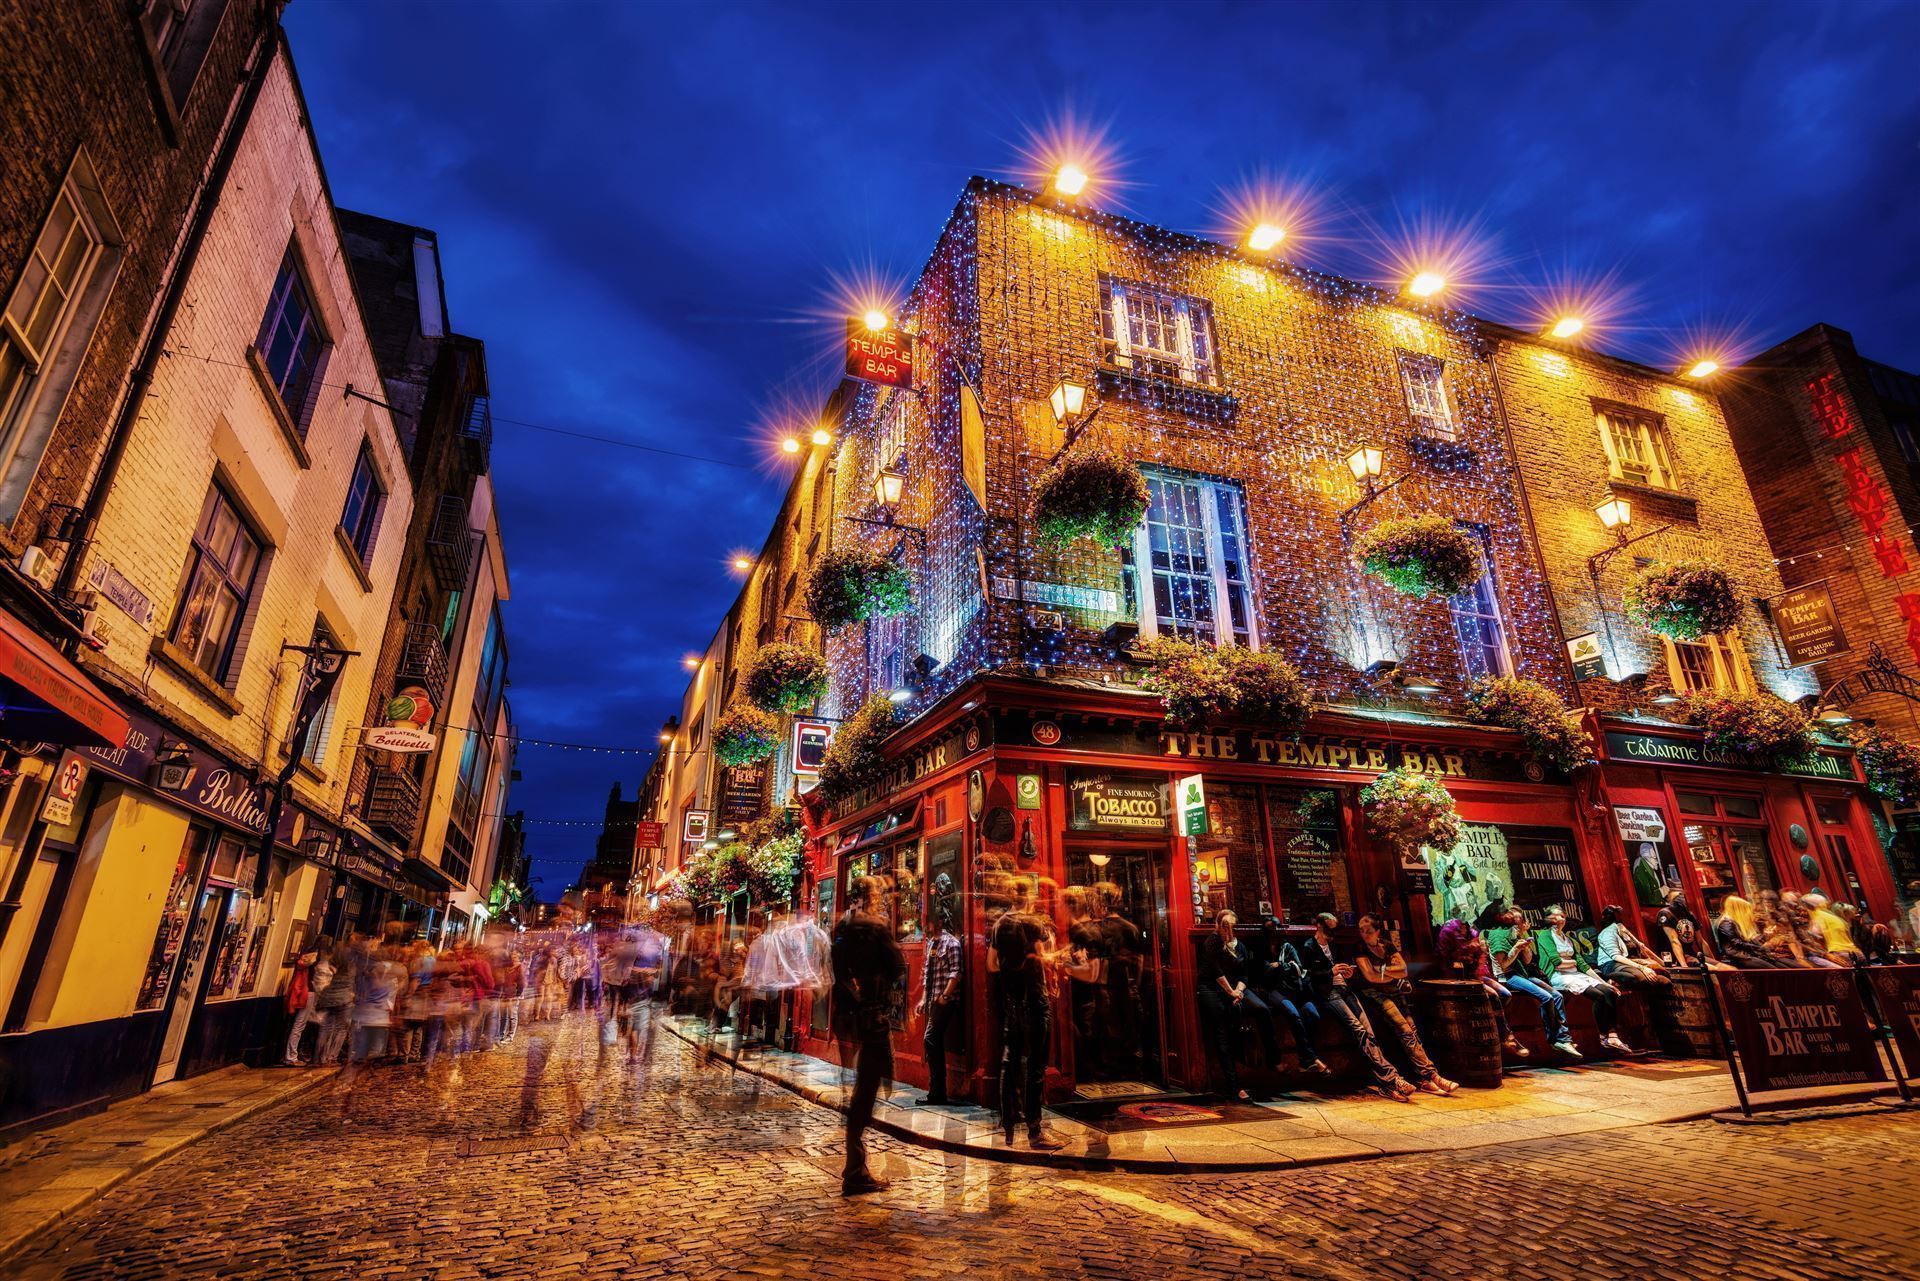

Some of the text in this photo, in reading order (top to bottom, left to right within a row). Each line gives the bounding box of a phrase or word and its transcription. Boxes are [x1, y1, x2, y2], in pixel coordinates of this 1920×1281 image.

[850, 338, 912, 364] TEMPLE
[865, 358, 898, 378] BAR
[1805, 373, 1853, 438] THE
[1834, 447, 1910, 578] TEMPLE
[1051, 594, 1071, 604] LANE
[1791, 593, 1806, 602] THE
[1779, 600, 1825, 618] TEMPLE
[1792, 611, 1818, 625] BAR
[1788, 624, 1834, 642] BEER GARDEN
[1797, 641, 1836, 655] LIVE MUSIC
[1808, 648, 1828, 658] DAILY
[384, 730, 421, 739] GELATERIA
[968, 731, 977, 747] 48
[1037, 725, 1056, 739] 48
[373, 735, 432, 749] Botticelli
[1160, 731, 1467, 778] THE TEMPLE BAR
[838, 745, 947, 818] THE TEMPLE BAR
[1070, 774, 1112, 791] Importers
[199, 768, 285, 832] Bottice
[1107, 788, 1156, 798] FINE SMOKING
[1082, 791, 1157, 821] TOBACCO
[1099, 815, 1128, 825] Always
[1141, 818, 1165, 827] Stock
[1616, 809, 1631, 820] Beer
[1631, 810, 1655, 822] Garden
[1619, 820, 1646, 833] Smoking
[1626, 830, 1642, 840] Area
[1286, 833, 1331, 851] TEMPLE BAR
[1466, 844, 1495, 860] BAR
[1544, 844, 1569, 862] THE
[1521, 862, 1573, 881] EMPEROR
[1562, 883, 1576, 900] OF
[1755, 996, 1842, 1029] THE TEMPLE
[1759, 1022, 1833, 1056] BAR DUBLIN
[1768, 1070, 1869, 1088] www.thetemplebarpub.com
